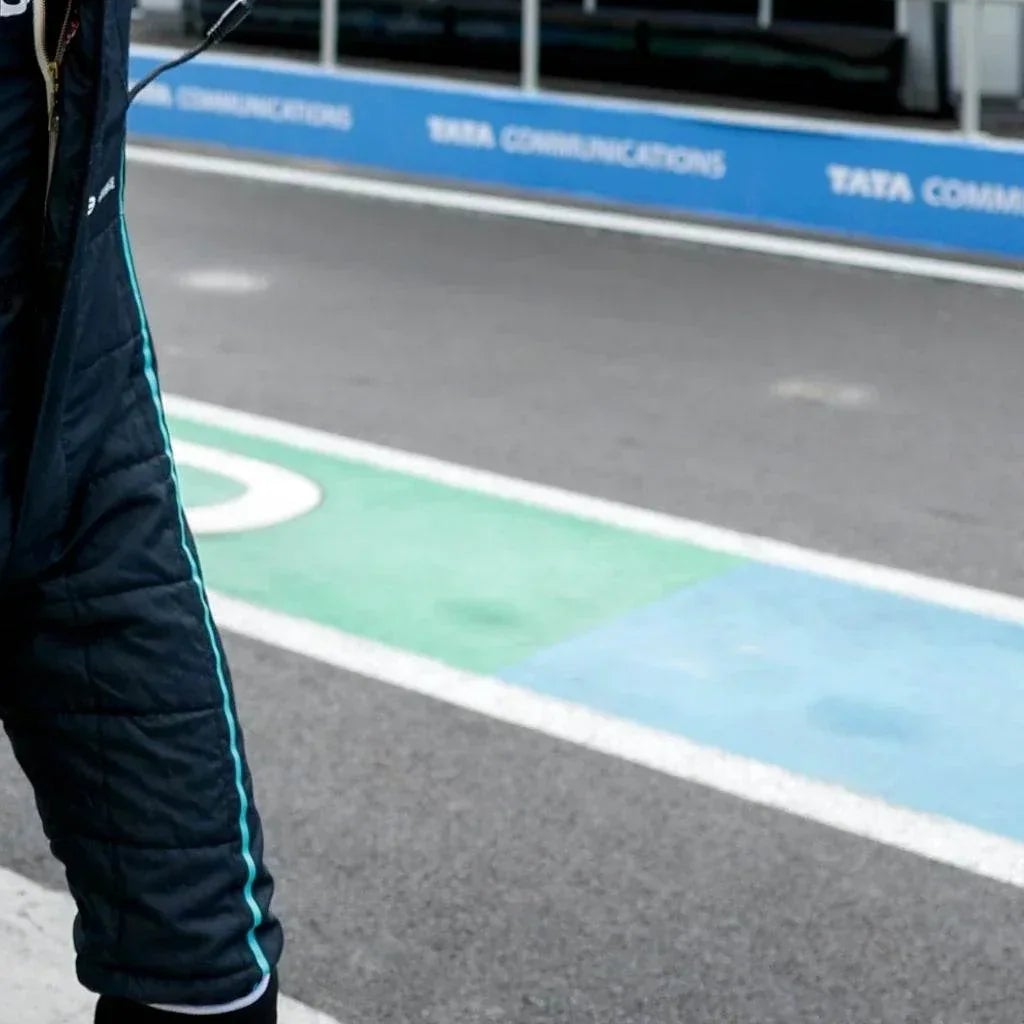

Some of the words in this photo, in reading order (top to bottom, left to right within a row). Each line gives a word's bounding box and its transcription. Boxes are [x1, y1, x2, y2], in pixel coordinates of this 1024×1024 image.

[427, 115, 496, 149] TATA
[499, 125, 727, 180] COMMUNICATIONS
[827, 164, 914, 204] TATA
